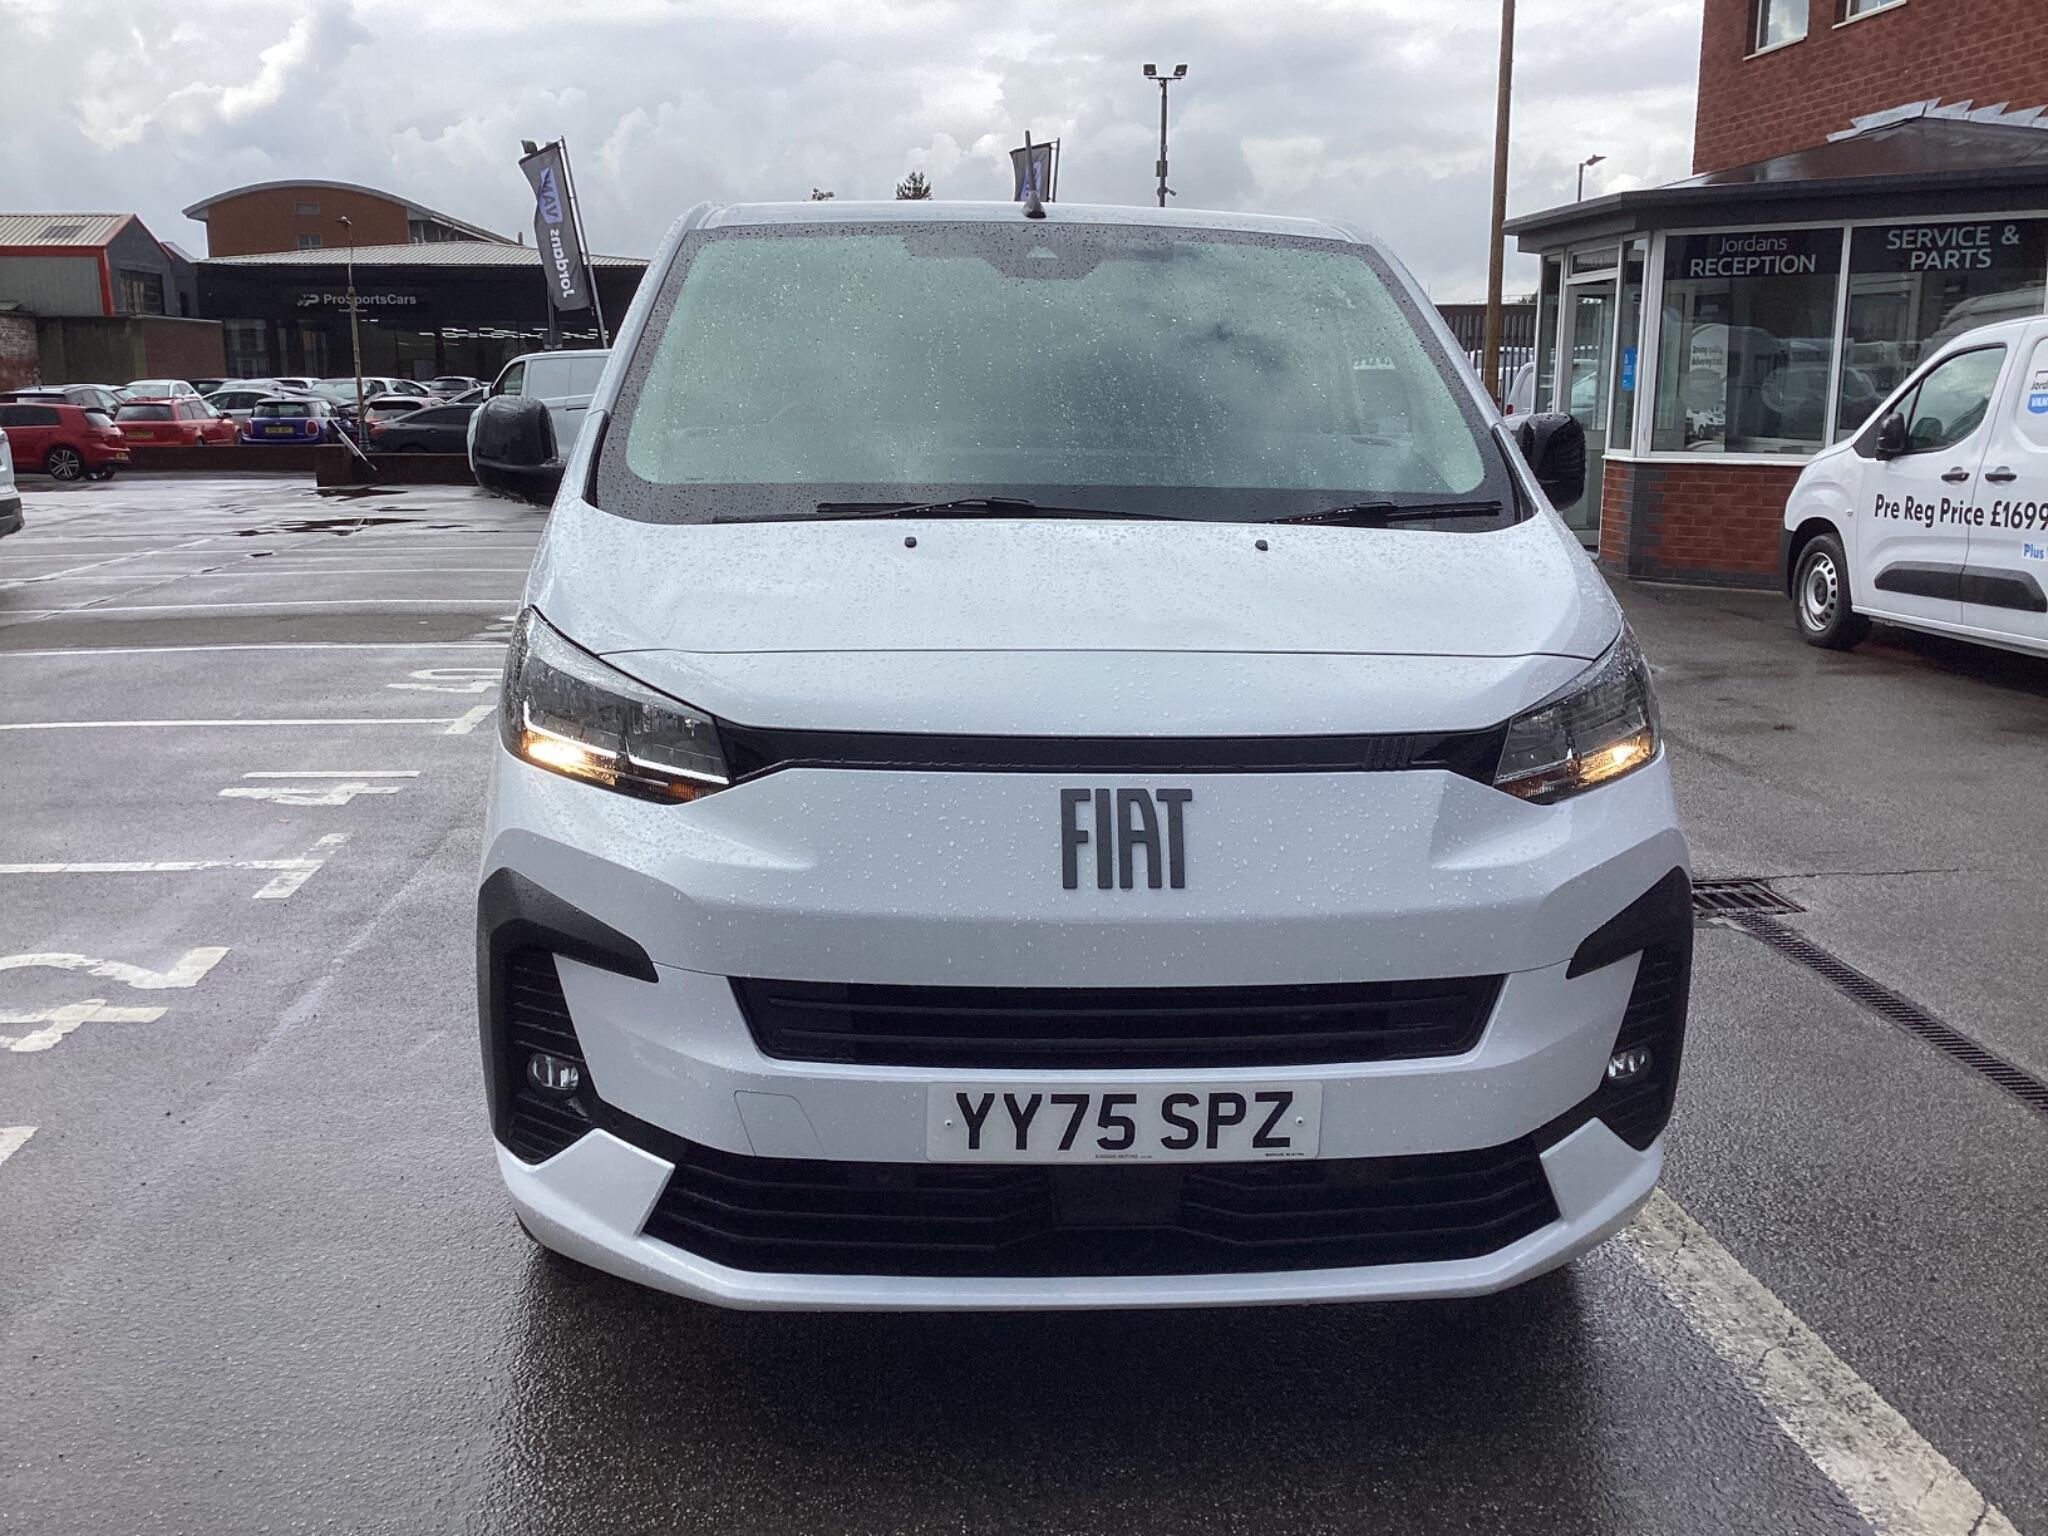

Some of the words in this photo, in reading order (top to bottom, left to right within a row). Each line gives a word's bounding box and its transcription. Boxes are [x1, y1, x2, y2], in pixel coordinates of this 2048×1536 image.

[1719, 236, 1788, 254] Jordans
[1887, 226, 1991, 250] SERVICE
[2001, 225, 2020, 245] &
[1690, 254, 1816, 277] RECEPTION
[1910, 249, 1992, 270] PARTS
[1874, 494, 1900, 519] Pre
[1904, 496, 1935, 528] Reg
[1940, 498, 1985, 526] Price
[1990, 500, 2048, 530] £1699
[2023, 543, 2045, 559] Plus
[1060, 788, 1193, 889] FIAT
[955, 1092, 1138, 1151] YY75
[1160, 1091, 1294, 1150] SPZ
